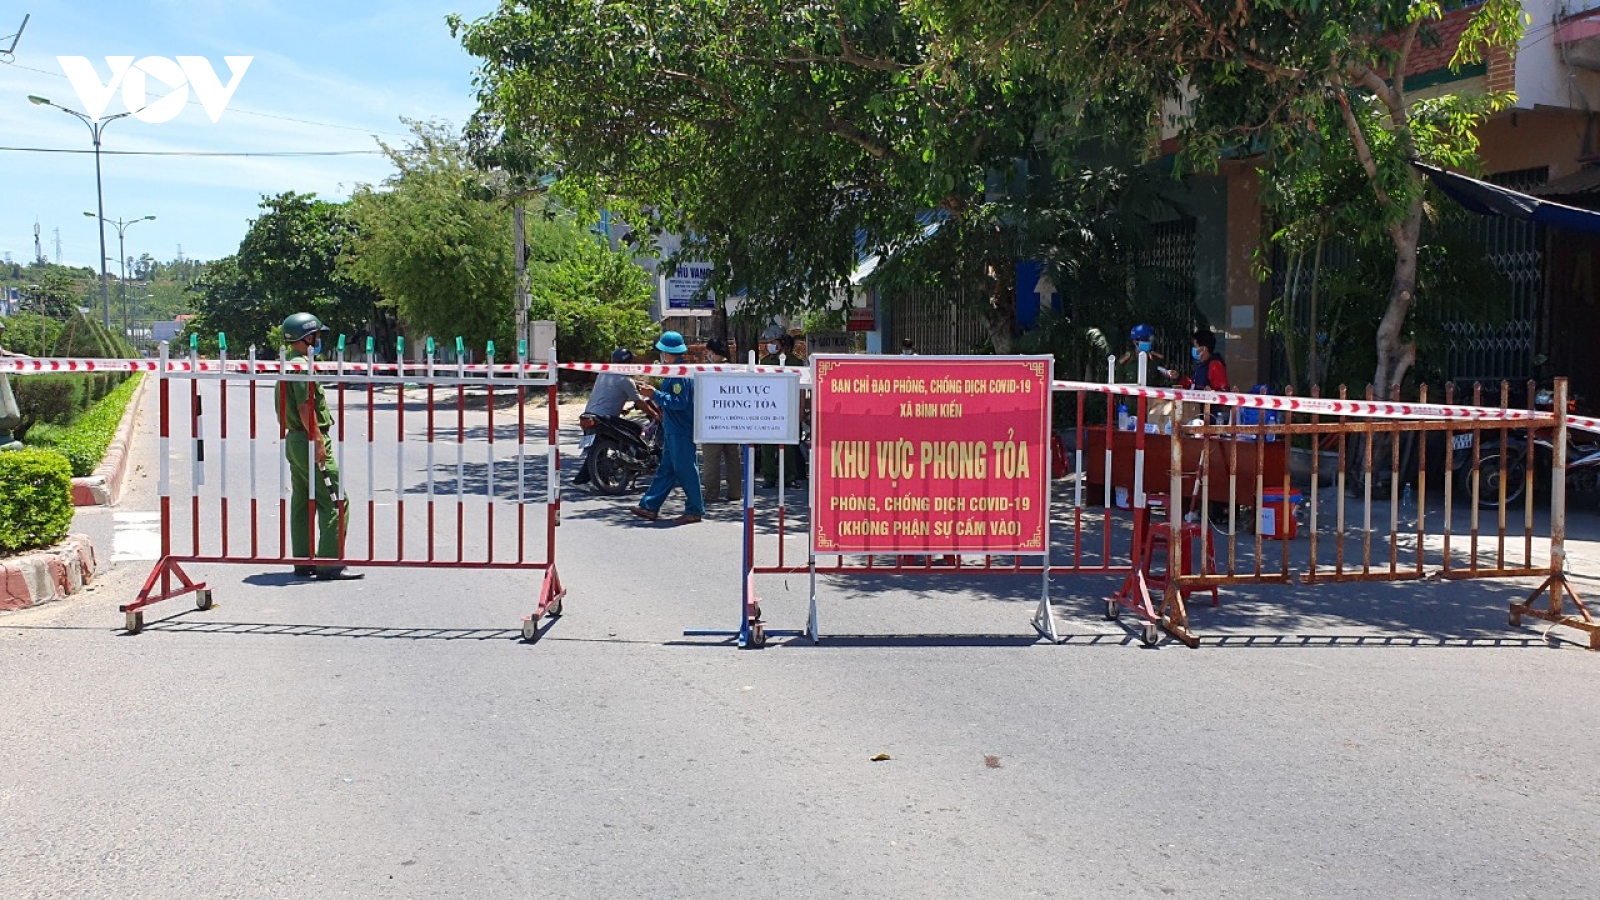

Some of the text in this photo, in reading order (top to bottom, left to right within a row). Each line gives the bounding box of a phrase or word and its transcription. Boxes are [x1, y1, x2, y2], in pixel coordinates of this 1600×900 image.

[719, 384, 771, 396] KHU VỰC
[831, 379, 850, 393] BAN
[871, 379, 891, 397] ĐẠO
[893, 376, 928, 395] PHÒNG,
[930, 375, 962, 394] CHỐNG
[965, 379, 986, 397] DỊCH
[989, 379, 1031, 394] COVID-19
[712, 399, 751, 409] PHONG
[900, 401, 912, 417] XÃ
[940, 399, 962, 417] KIẾN
[830, 427, 1030, 488] KHU VỰC PHONG TỎA
[830, 492, 1030, 514] PHÒNG, CHỐNG DỊCH COVID-19
[838, 516, 1021, 539] (KHÔNG PHẬN SỰ CẤM VÀO)
